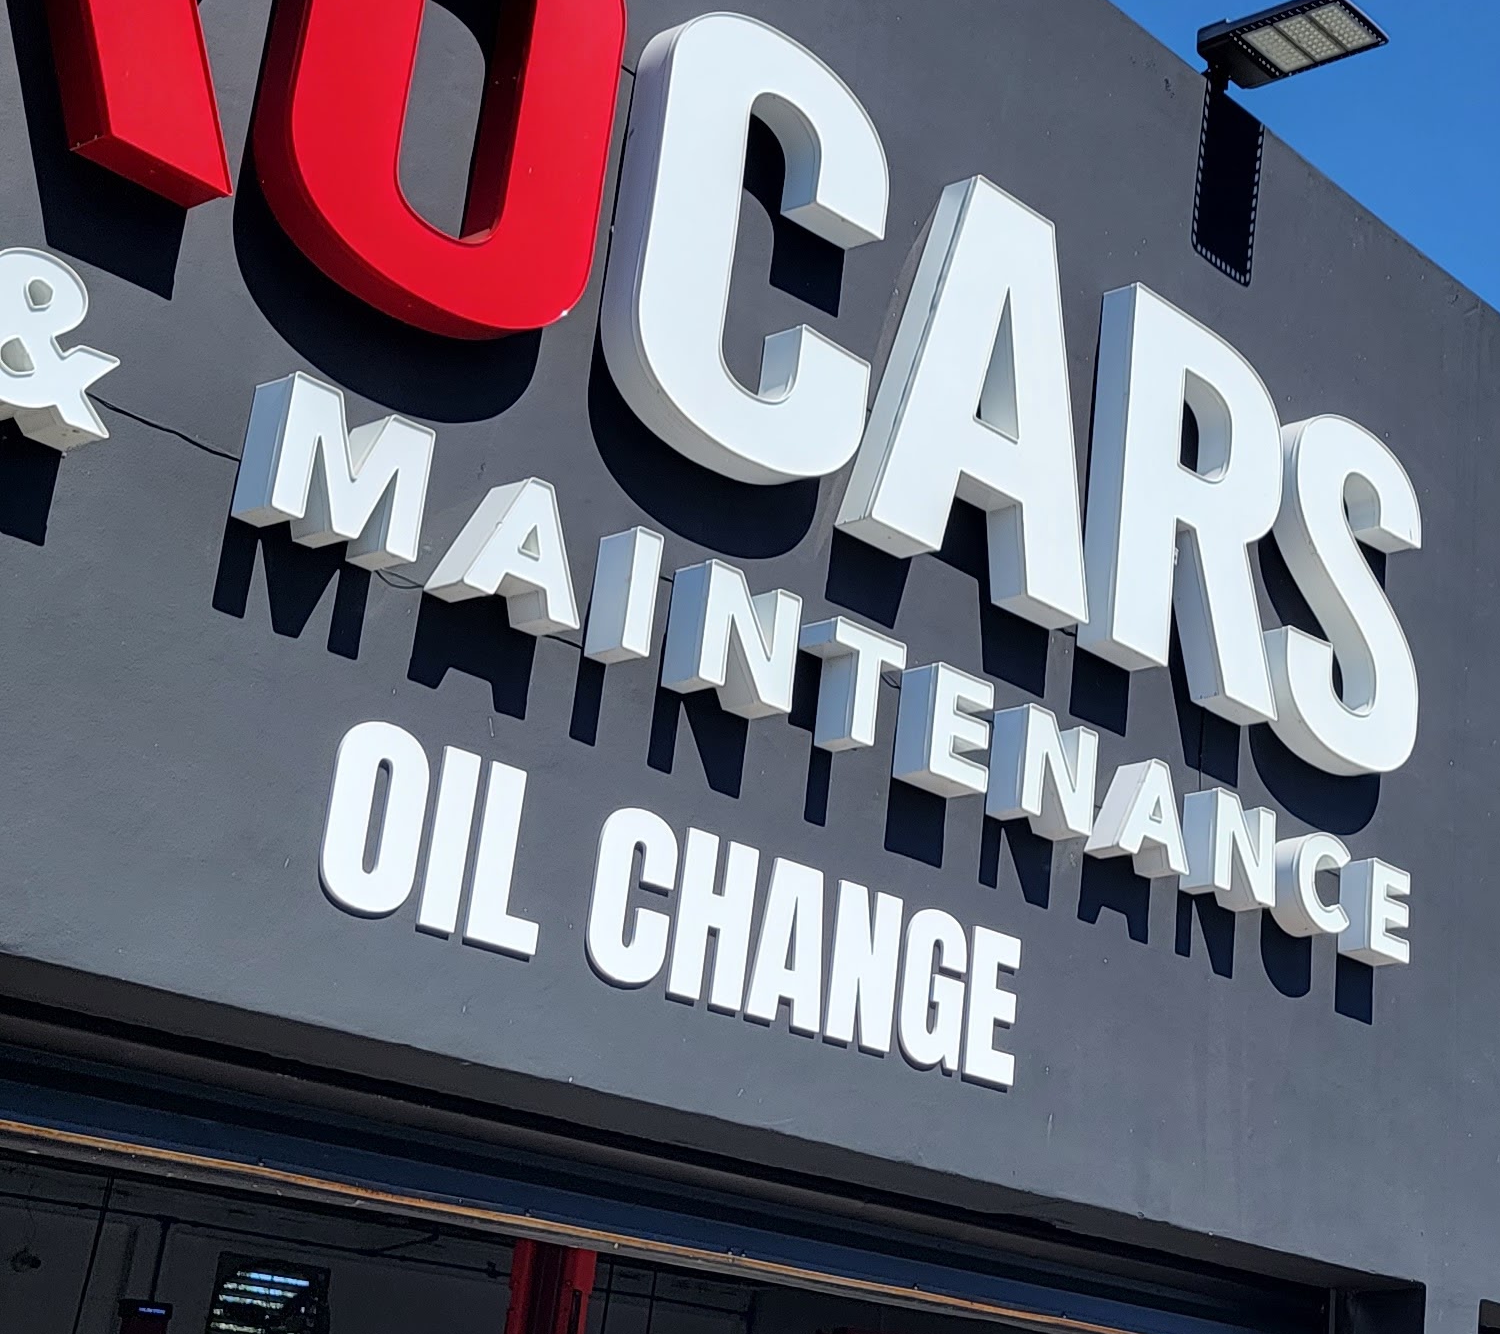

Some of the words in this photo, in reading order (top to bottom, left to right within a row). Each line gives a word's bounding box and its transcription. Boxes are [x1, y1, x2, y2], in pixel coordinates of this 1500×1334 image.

[0, 247, 119, 451] &
[231, 371, 1412, 966] MAINTENANCE
[320, 720, 540, 958] OIL
[588, 807, 1021, 1088] CHANGE
